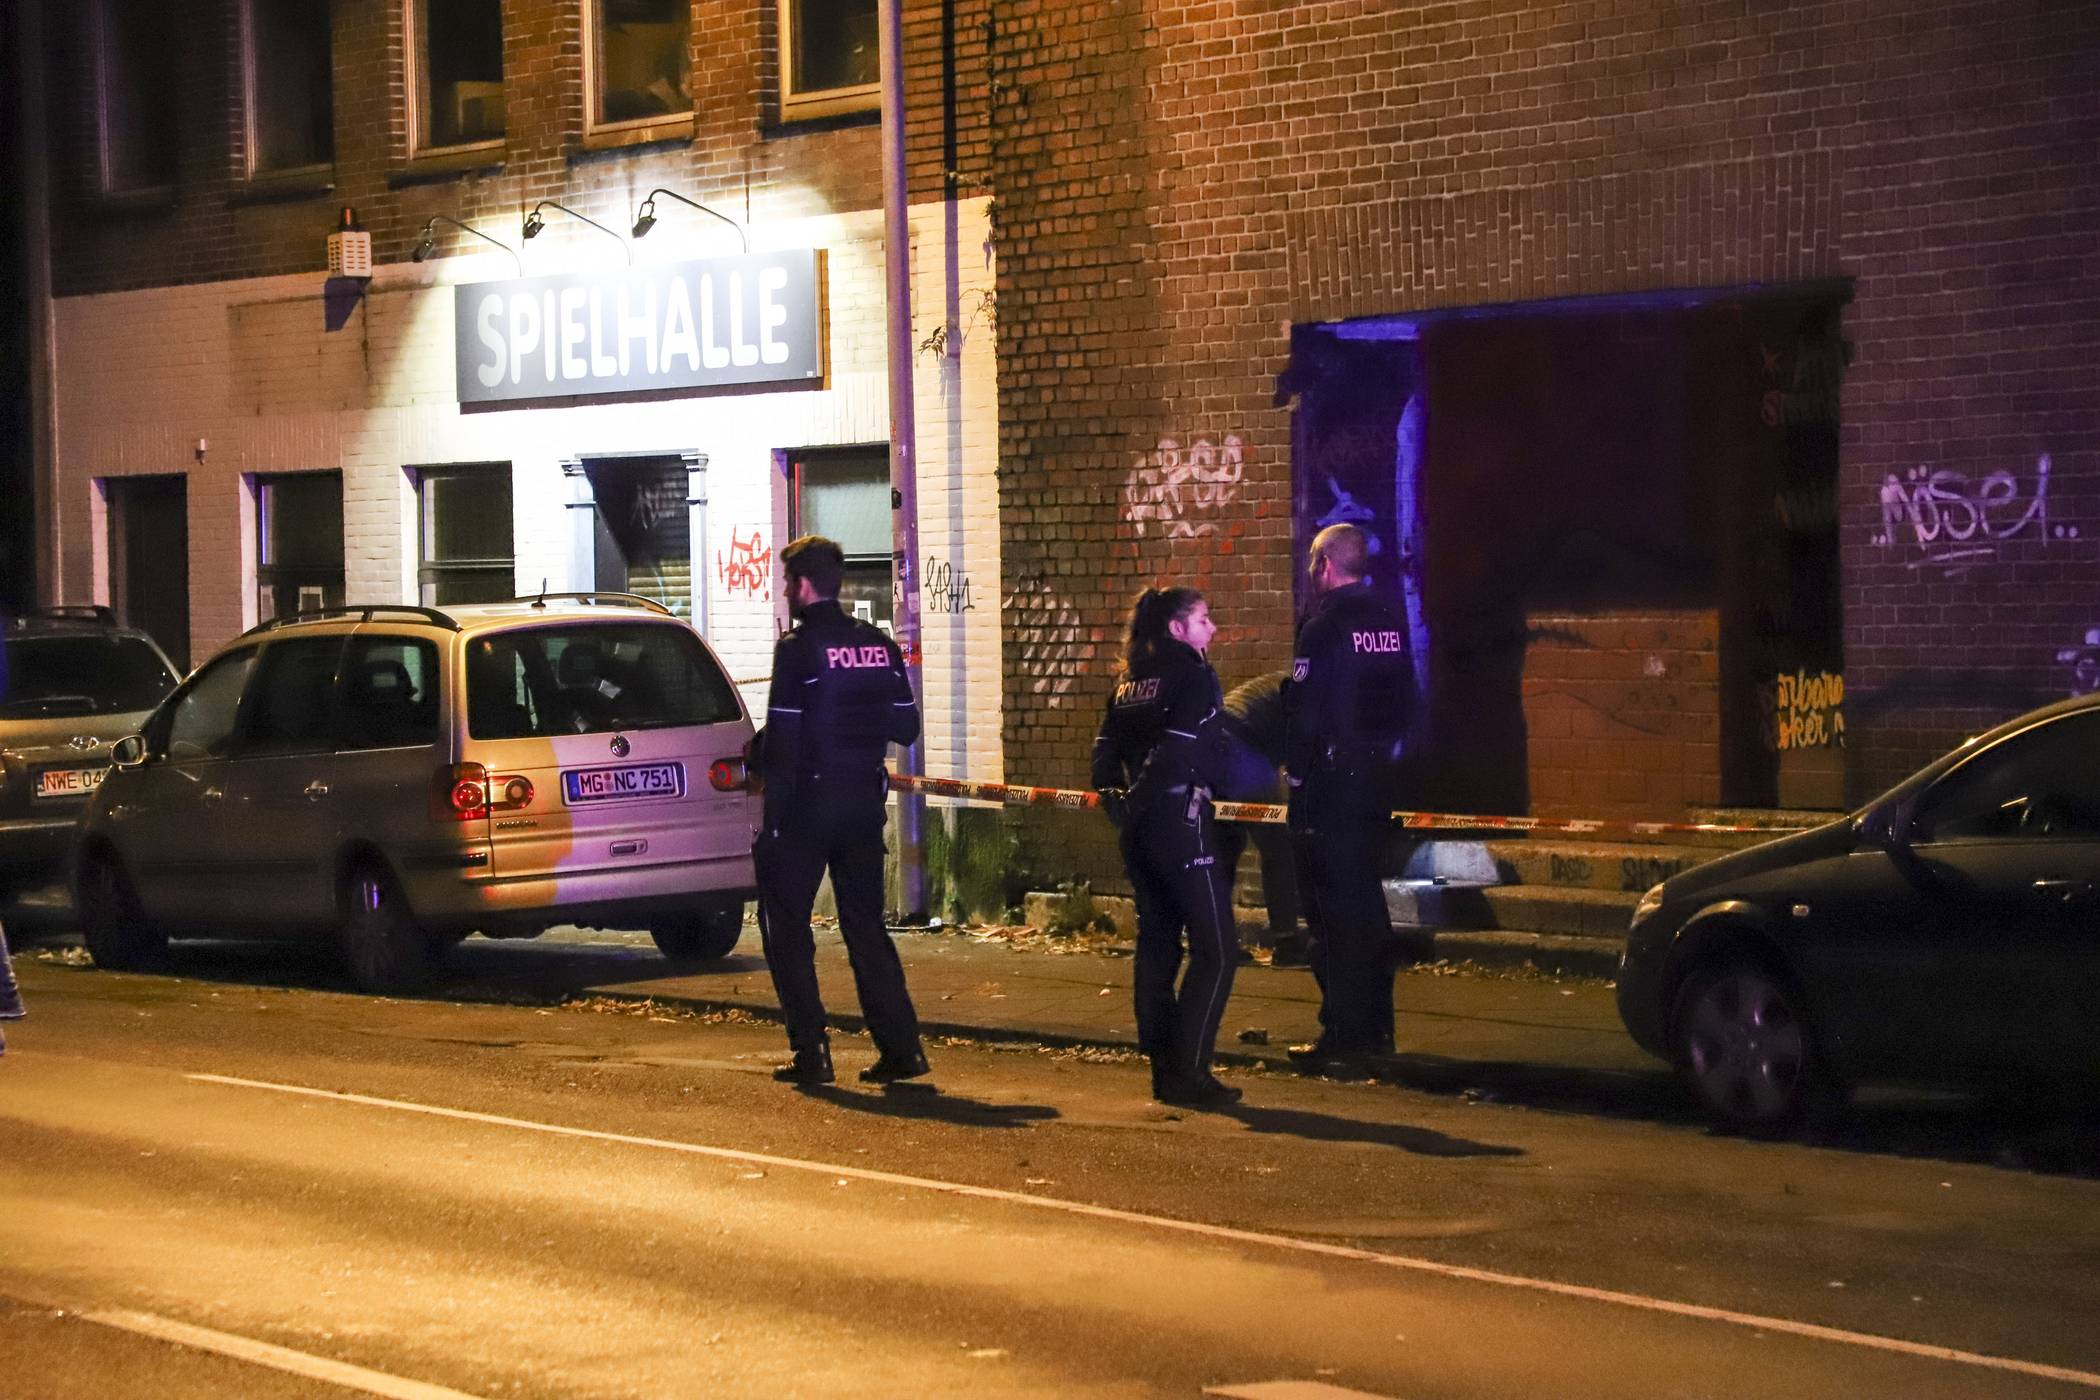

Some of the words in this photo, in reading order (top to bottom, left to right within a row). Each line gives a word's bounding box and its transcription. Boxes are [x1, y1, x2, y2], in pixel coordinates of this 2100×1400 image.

[477, 265, 790, 388] SPIELHALLE
[1352, 631, 1401, 653] POLIZEI
[826, 646, 890, 669] POLIZEI
[1114, 678, 1161, 705] POLIZEI
[44, 771, 78, 791] NWE
[579, 773, 604, 794] MG
[613, 770, 637, 791] NC
[640, 768, 672, 789] 751
